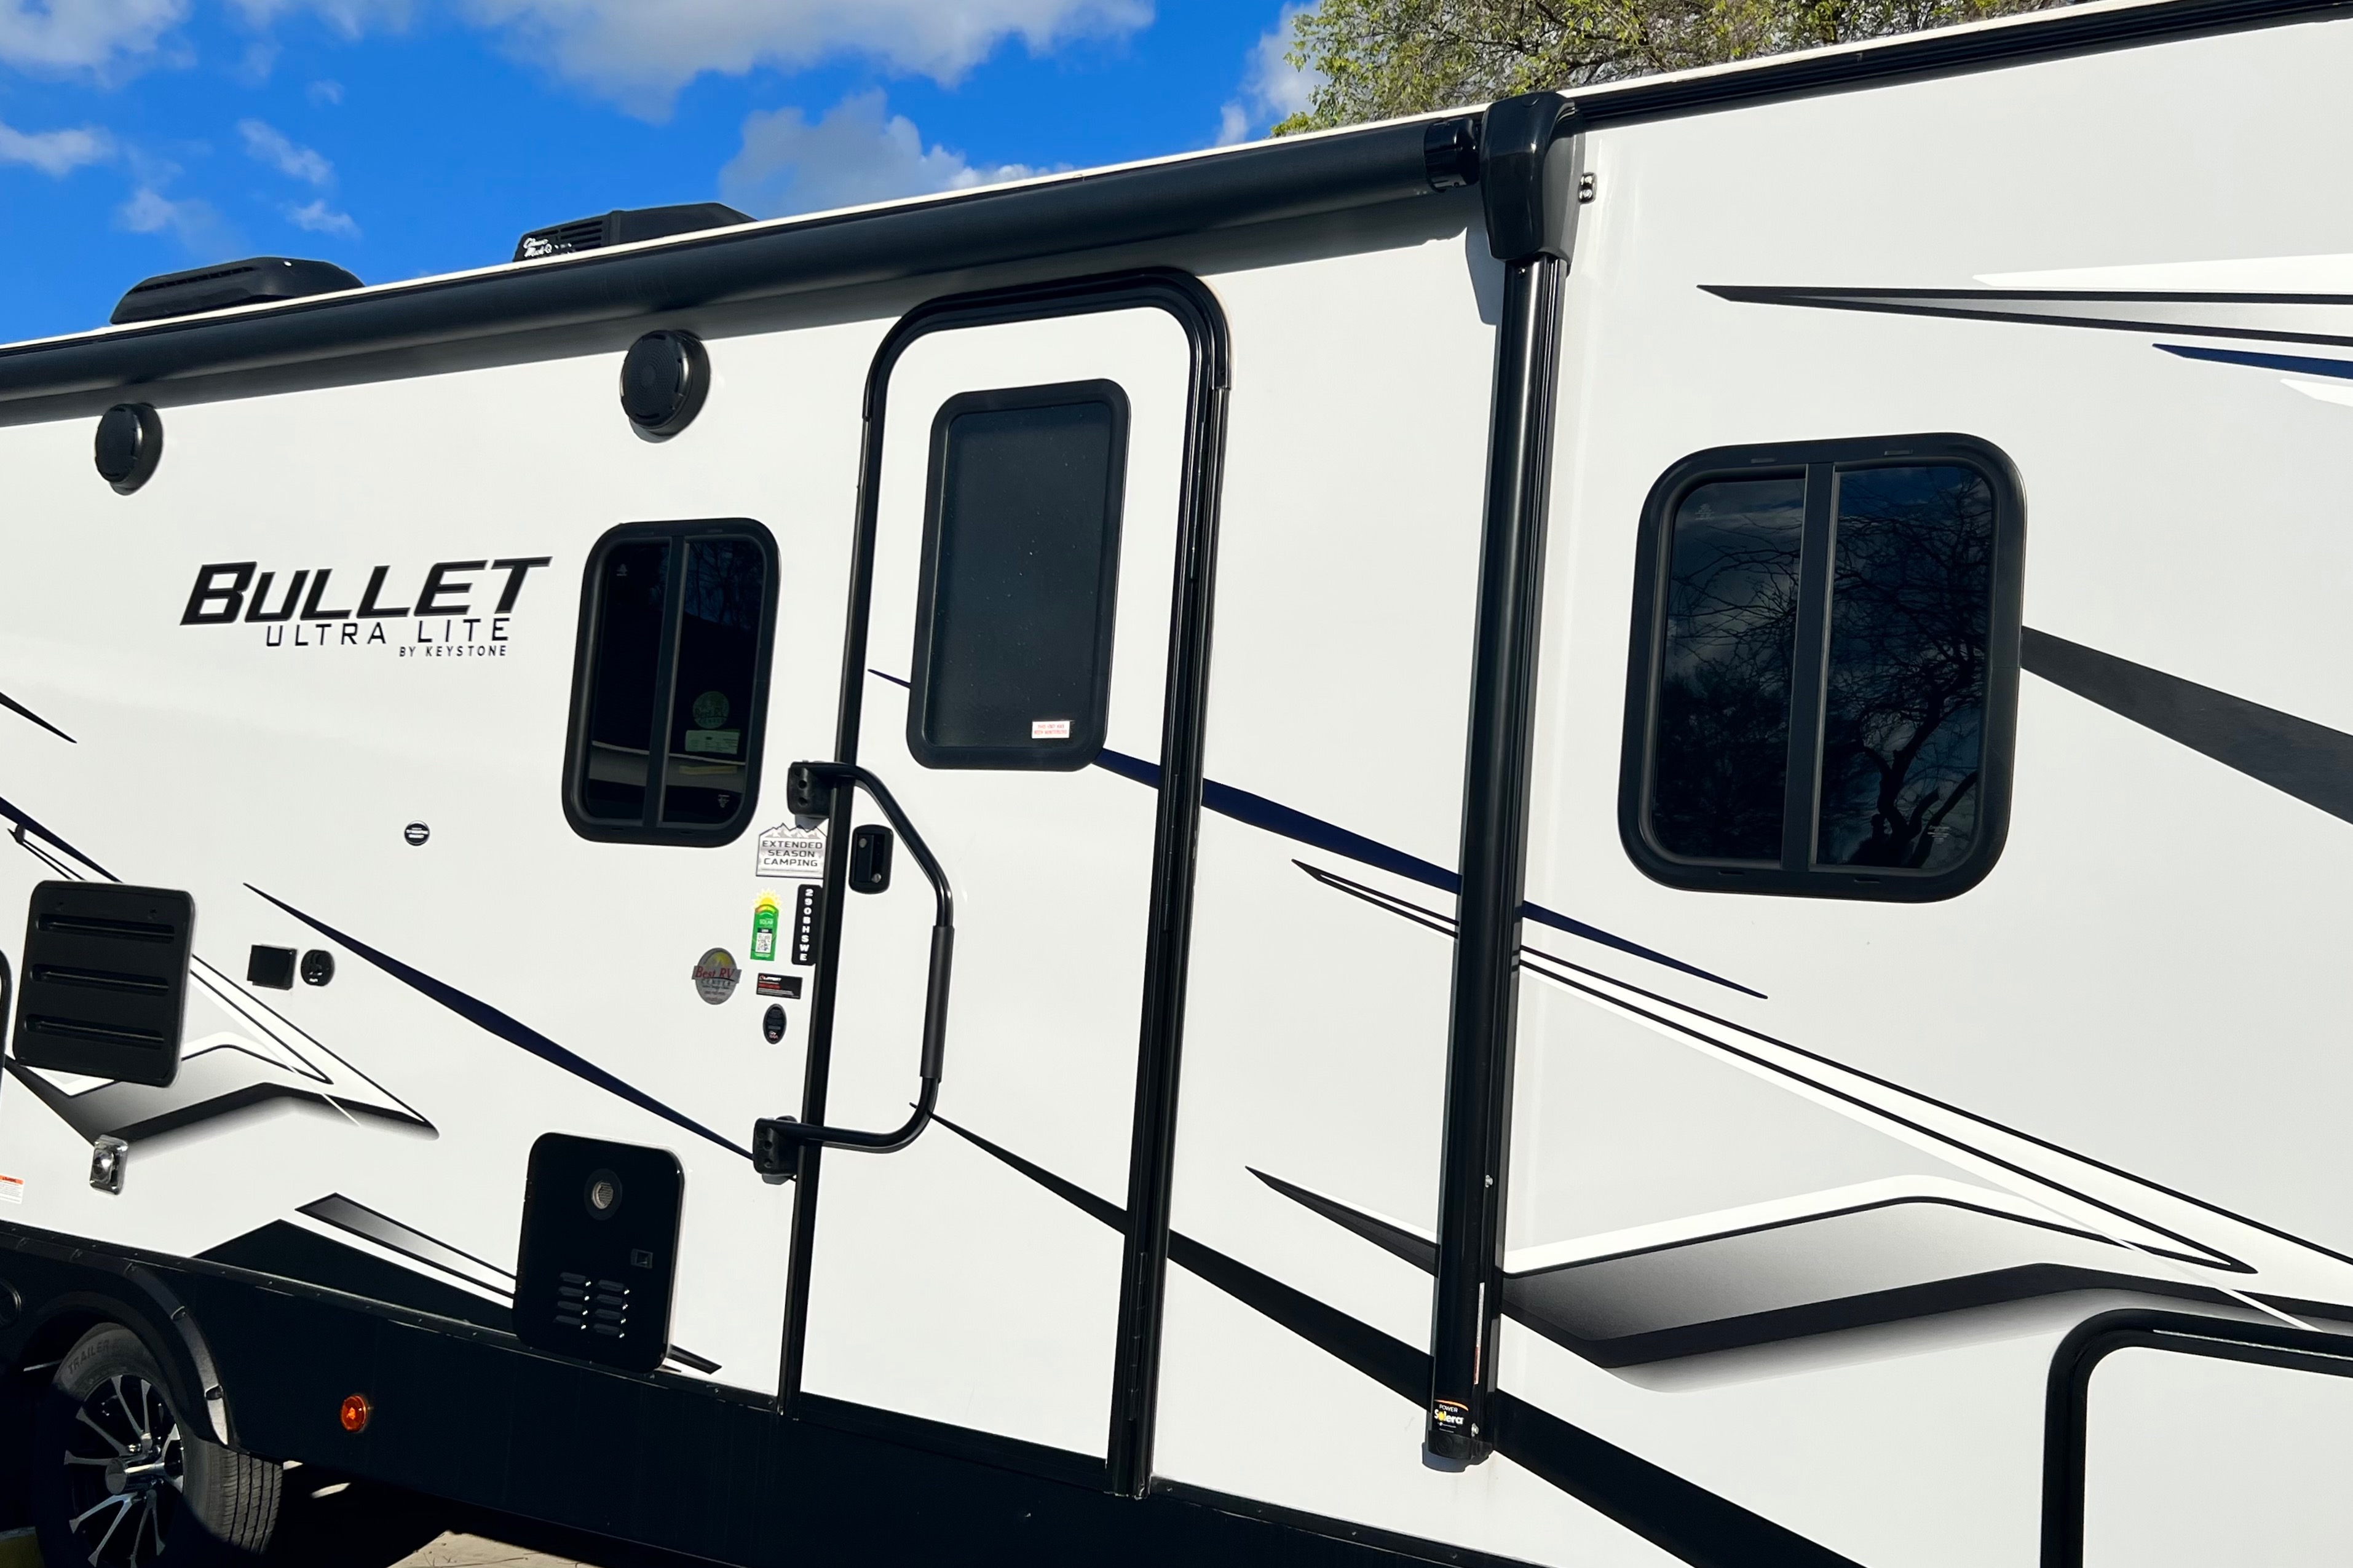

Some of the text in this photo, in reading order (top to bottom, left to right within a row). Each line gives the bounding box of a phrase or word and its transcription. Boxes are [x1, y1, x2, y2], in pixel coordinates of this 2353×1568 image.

[180, 556, 552, 625] BULLET
[266, 618, 510, 647] ULTRA LITE
[399, 645, 507, 657] BY KEYSTONE
[762, 840, 823, 849] EXTENDED
[768, 849, 815, 857] SEASON
[764, 857, 818, 867] CAMPING
[695, 966, 735, 979] Best RV
[68, 1339, 109, 1374] TRAILER
[1439, 1404, 1458, 1412] POWER
[1434, 1409, 1465, 1425] Solera
